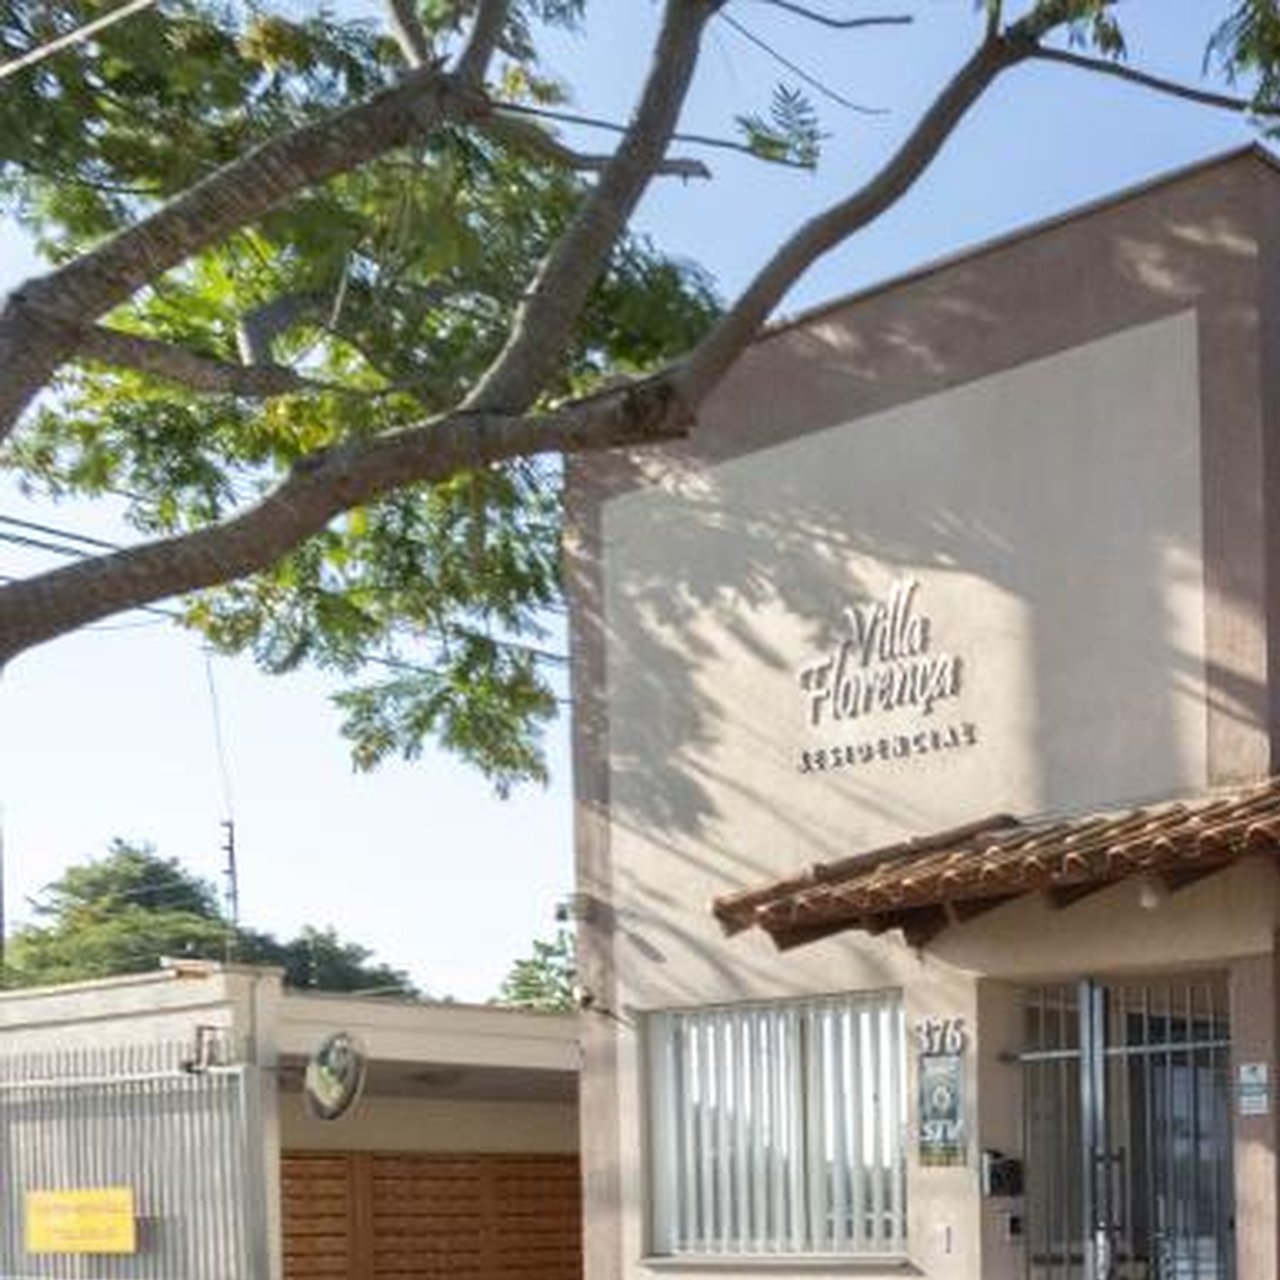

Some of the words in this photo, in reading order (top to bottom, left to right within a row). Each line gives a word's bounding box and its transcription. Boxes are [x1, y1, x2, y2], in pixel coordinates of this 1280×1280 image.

[845, 580, 931, 667] Villa
[798, 640, 964, 726] Florença
[918, 1119, 964, 1142] STV
